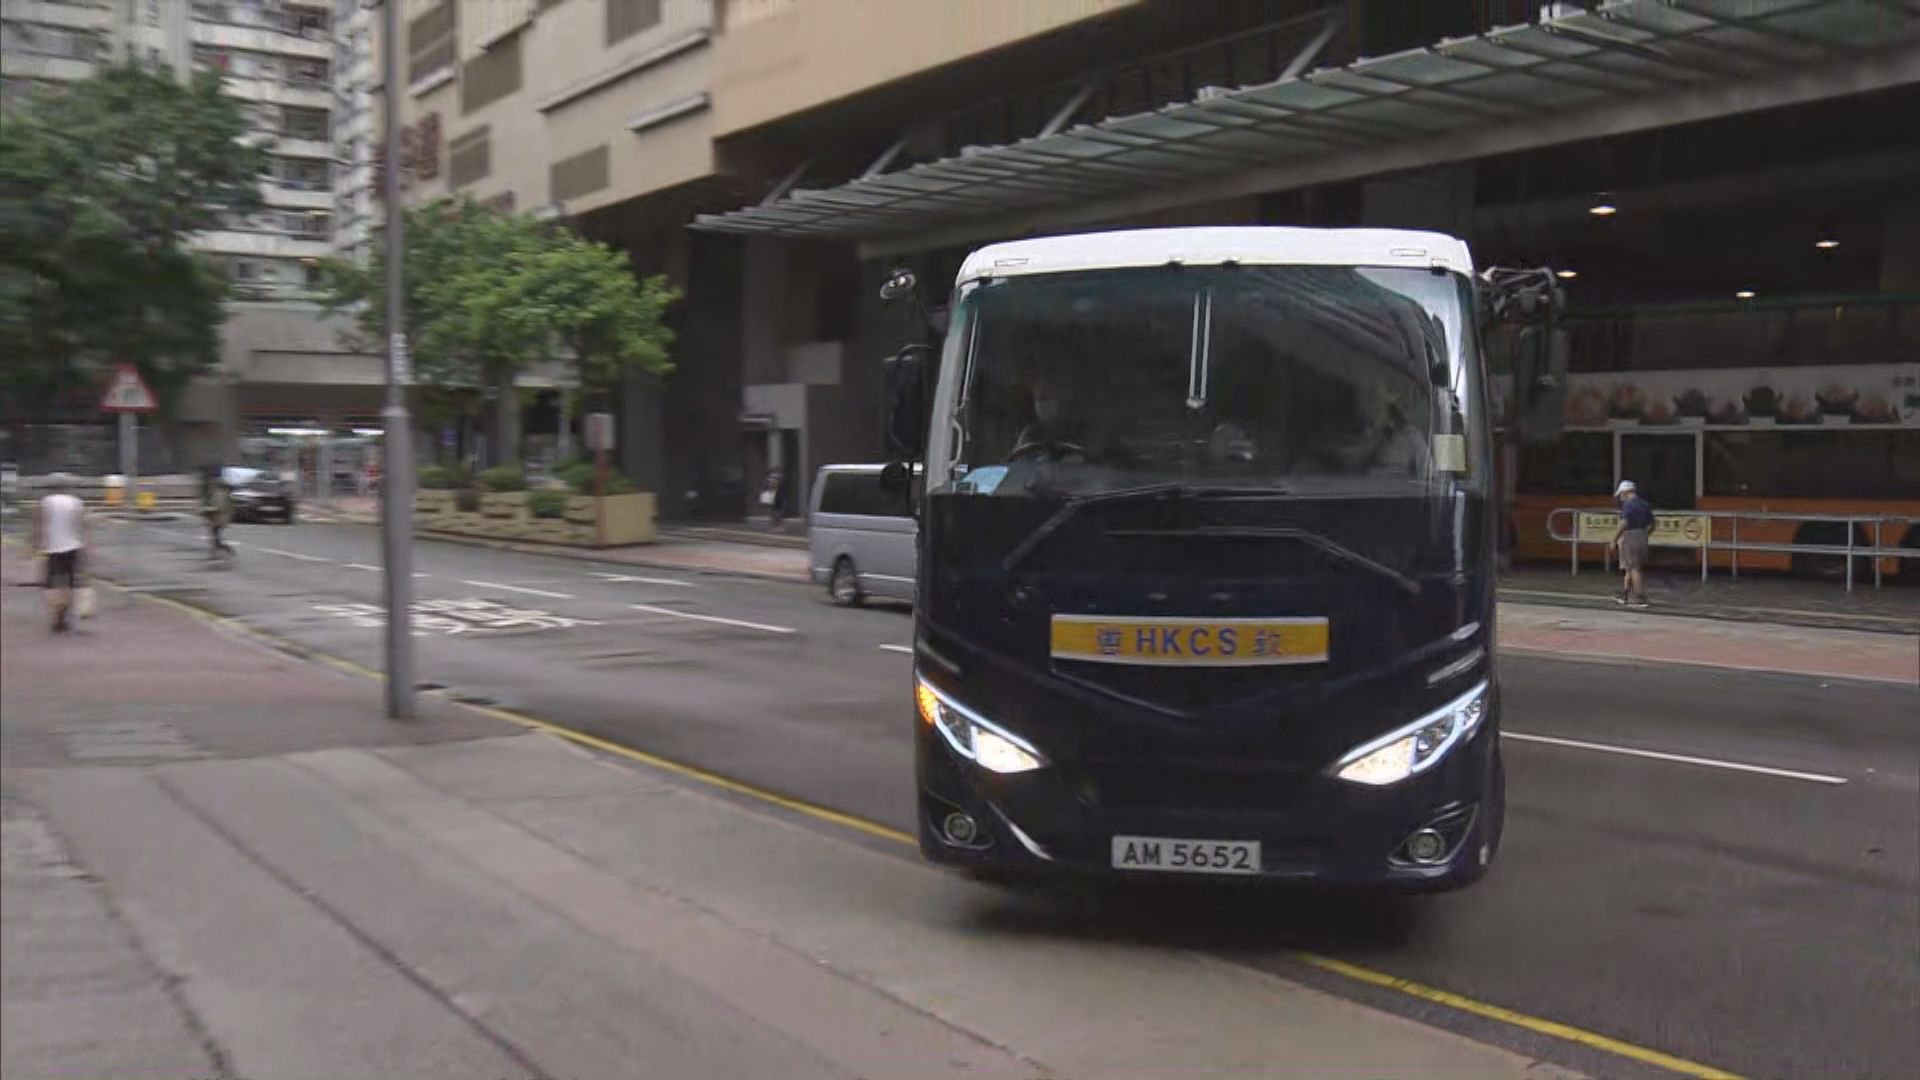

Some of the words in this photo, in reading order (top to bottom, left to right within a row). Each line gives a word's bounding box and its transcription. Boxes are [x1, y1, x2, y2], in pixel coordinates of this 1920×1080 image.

[1136, 627, 1238, 656] HKCS
[1122, 842, 1161, 865] AM
[1170, 843, 1251, 869] 5652
